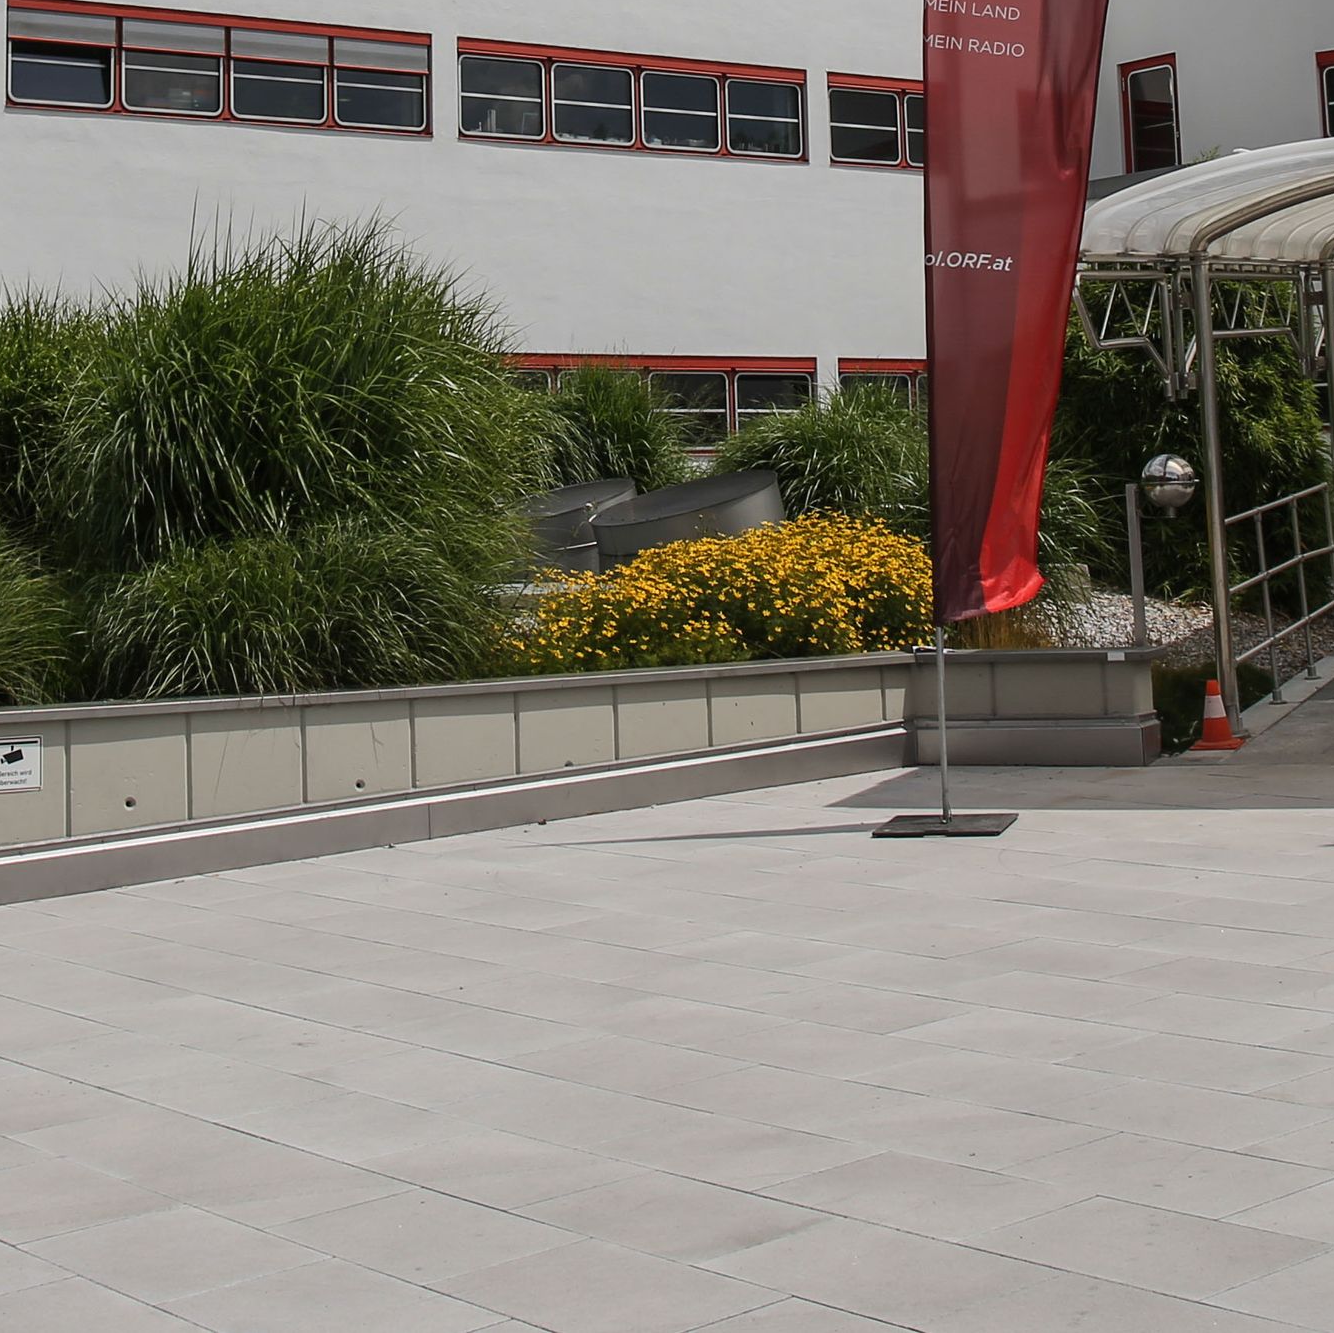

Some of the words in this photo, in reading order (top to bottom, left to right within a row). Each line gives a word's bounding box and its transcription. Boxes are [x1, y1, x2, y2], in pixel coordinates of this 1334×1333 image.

[971, 2, 1021, 21] LAND
[923, 33, 963, 51] MEIN
[968, 38, 1025, 57] RADIO
